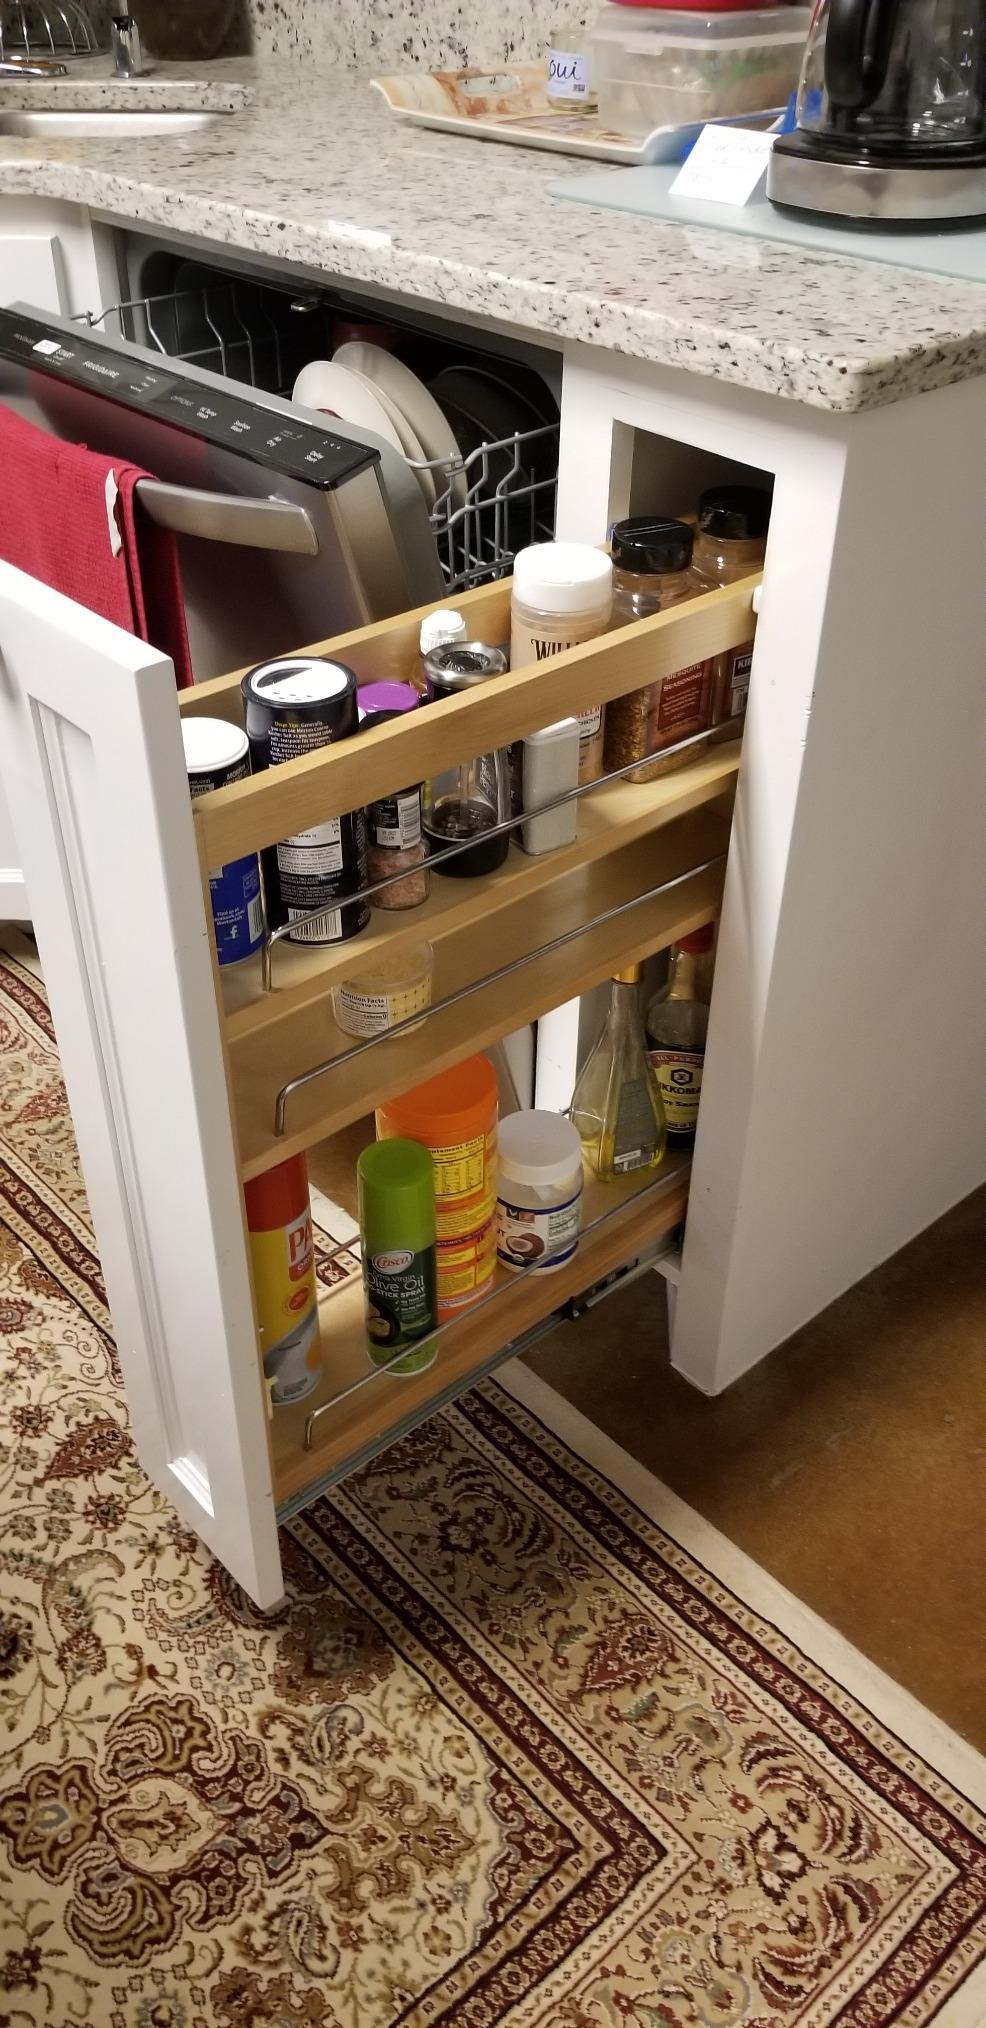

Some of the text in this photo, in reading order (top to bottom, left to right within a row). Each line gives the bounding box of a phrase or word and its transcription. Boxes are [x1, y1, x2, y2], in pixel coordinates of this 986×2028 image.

[82, 360, 120, 378] FRIGIDAIRE
[663, 672, 702, 692] SEASONING
[660, 1083, 701, 1094] IKKOMA
[377, 1256, 409, 1269] Crisco
[368, 1272, 424, 1292] Olive Oil
[391, 1274, 416, 1283] Virgin
[400, 1286, 425, 1298] SPRAY
